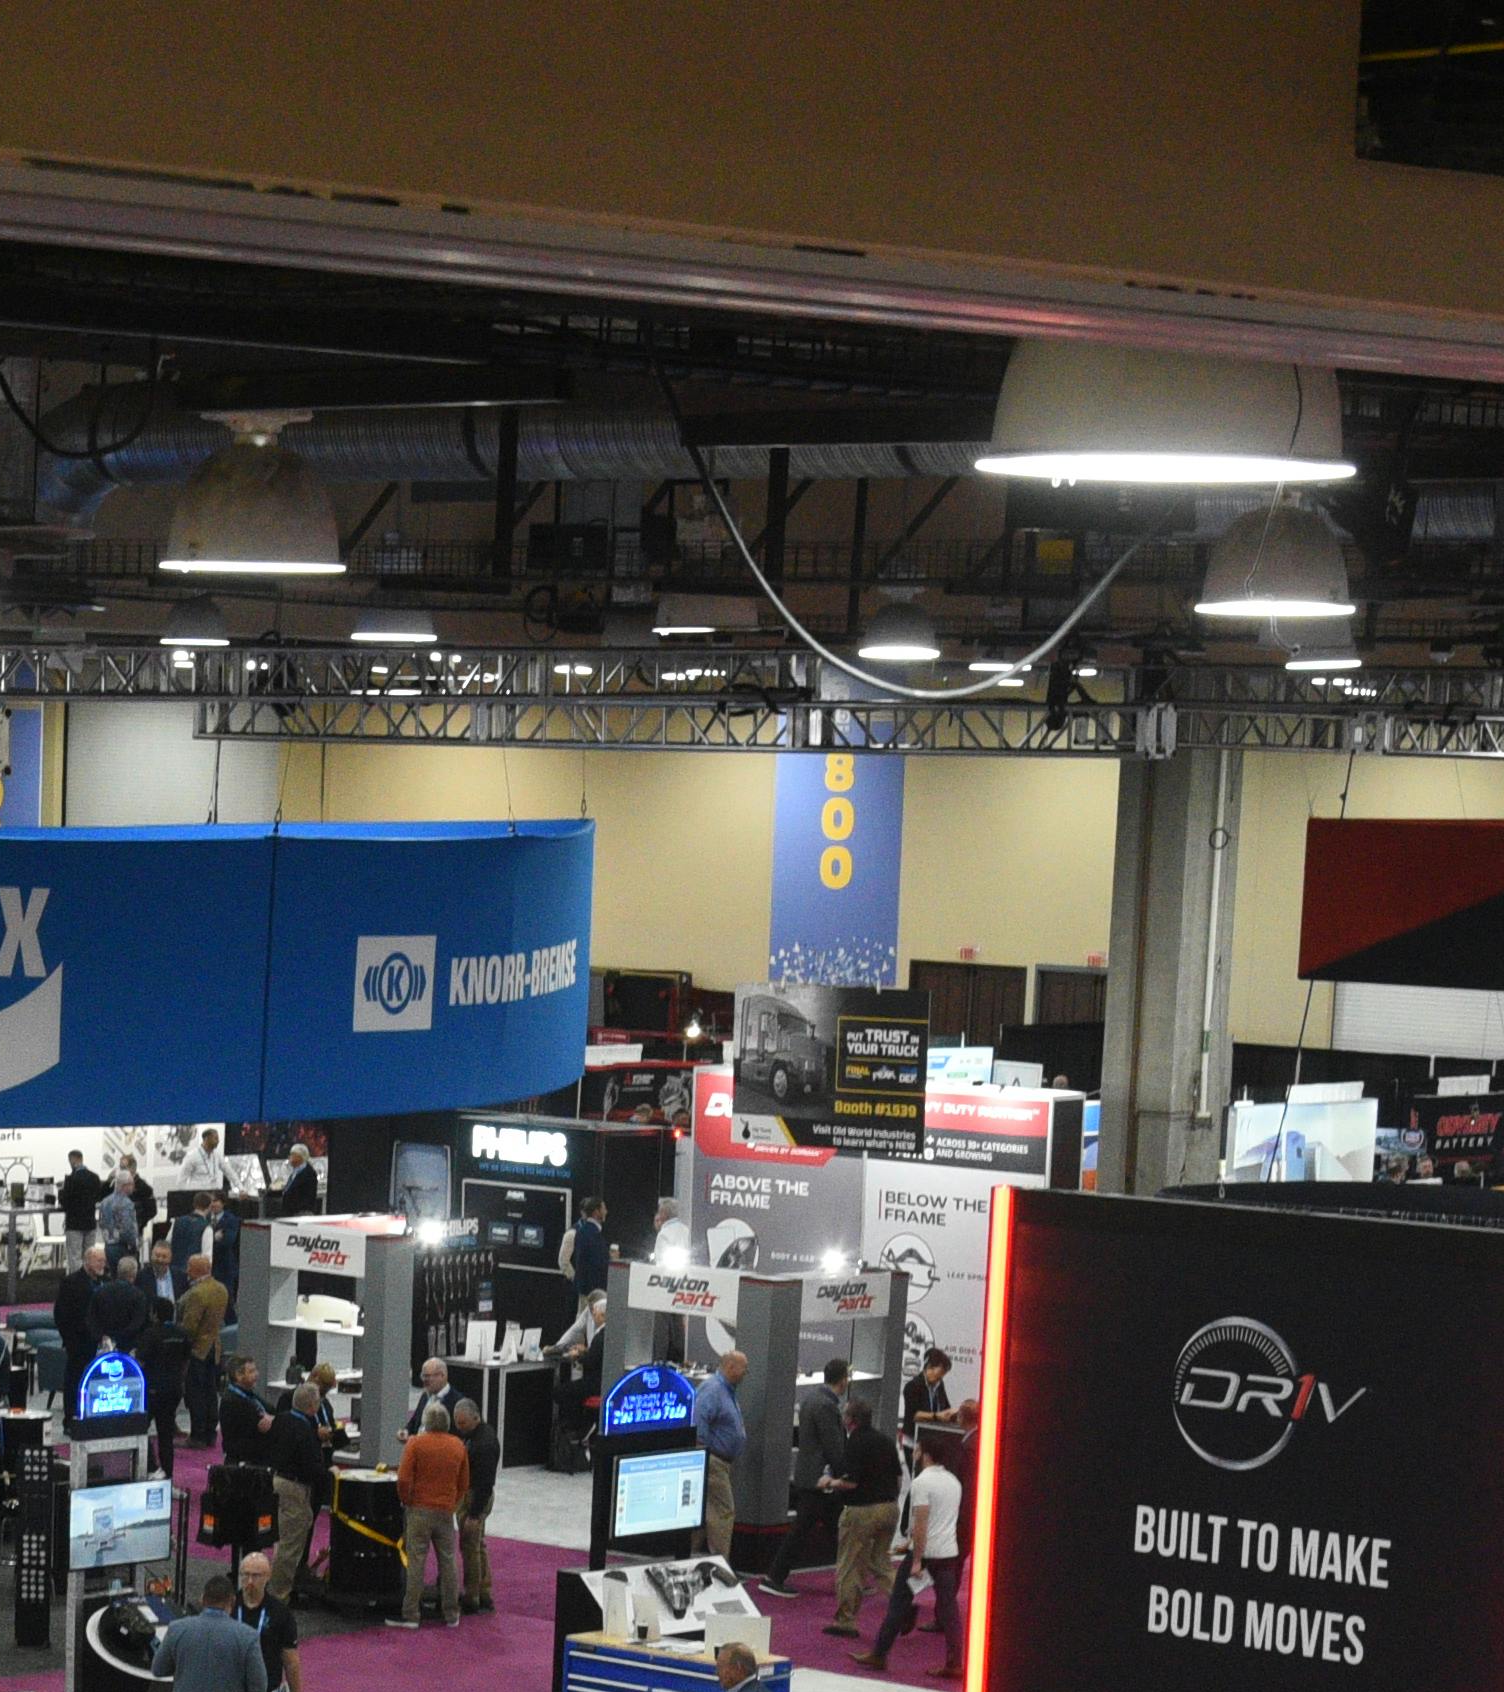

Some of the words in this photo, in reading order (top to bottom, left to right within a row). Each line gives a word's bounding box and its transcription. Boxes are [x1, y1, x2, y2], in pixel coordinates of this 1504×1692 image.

[449, 938, 577, 1006] KNORR-BREMSE
[847, 1043, 879, 1055] YOUR
[881, 1045, 919, 1057] TRUCK
[1435, 1137, 1494, 1149] BATTERY
[711, 1173, 772, 1195] ABOVE
[774, 1178, 810, 1198] THE
[710, 1190, 771, 1210] FRAME
[885, 1191, 948, 1210] BELOW
[952, 1195, 989, 1213] THE
[884, 1207, 948, 1227] FRAME
[286, 1234, 341, 1257] Dayton
[647, 1274, 710, 1297] Dayton
[816, 1281, 868, 1303] Dayton
[1134, 1505, 1228, 1564] BUILT
[1237, 1519, 1279, 1572] TO
[1289, 1527, 1391, 1588] MAKE
[1148, 1584, 1235, 1644] BOLD
[1244, 1600, 1366, 1665] MOVES
